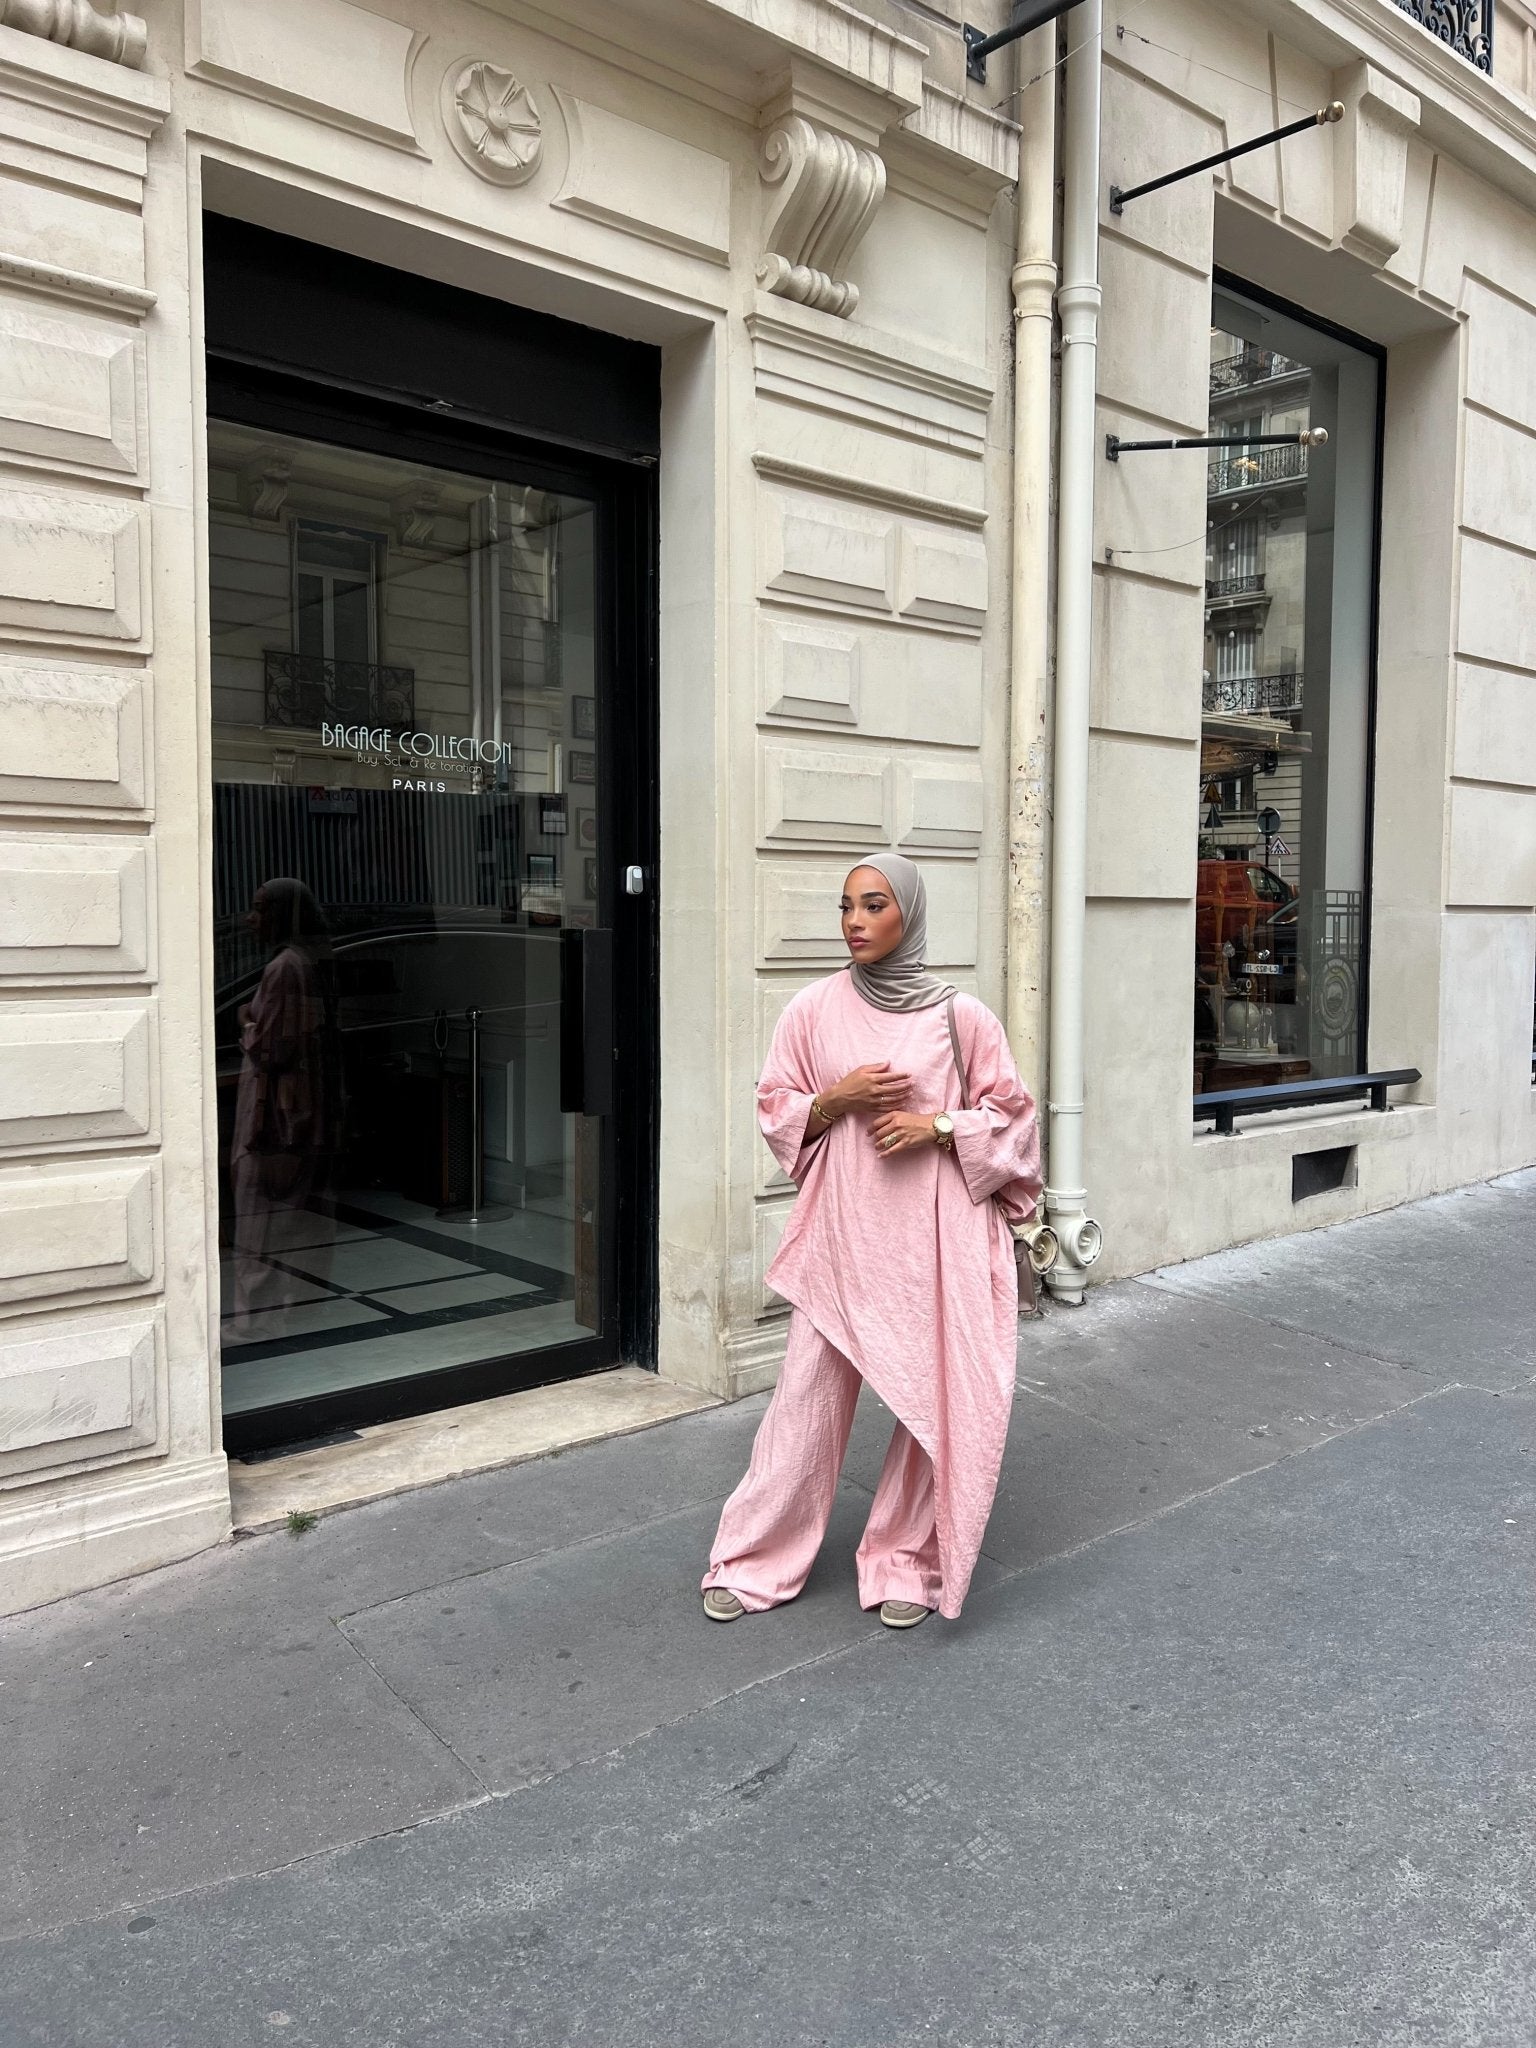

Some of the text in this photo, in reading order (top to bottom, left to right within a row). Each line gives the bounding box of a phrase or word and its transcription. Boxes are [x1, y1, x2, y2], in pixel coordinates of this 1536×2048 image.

[322, 722, 512, 764] BAGAGE COLLECTION
[409, 756, 419, 769] &
[424, 757, 482, 774] Retoration
[393, 779, 446, 793] PARIS
